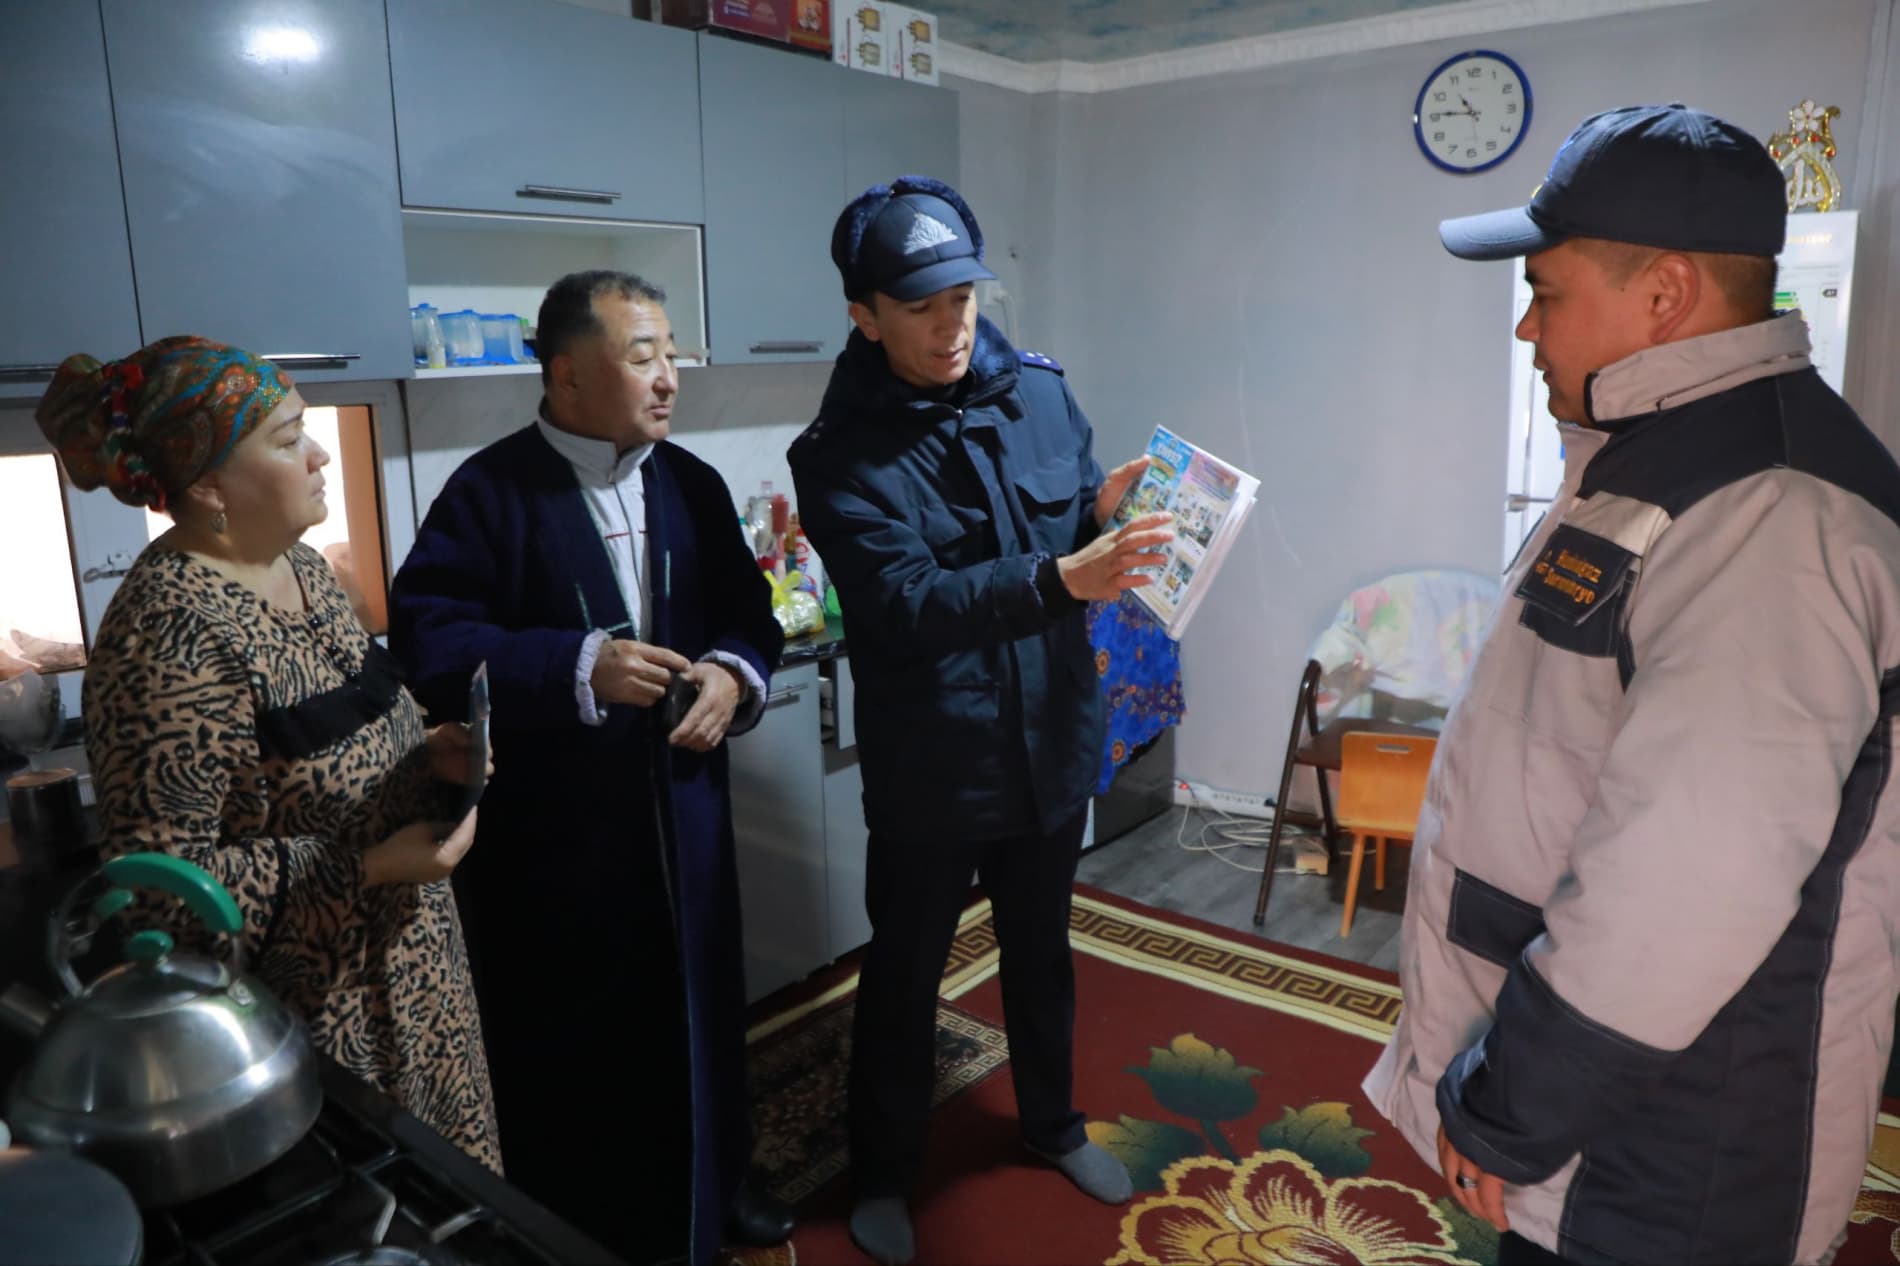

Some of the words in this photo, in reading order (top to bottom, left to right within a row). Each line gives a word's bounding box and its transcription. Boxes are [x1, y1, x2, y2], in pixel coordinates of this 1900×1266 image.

[1450, 75, 1459, 85] 11
[1502, 83, 1513, 94] 2
[1433, 92, 1447, 102] 10
[1507, 103, 1517, 114] 3
[1430, 113, 1441, 122] 9
[1434, 131, 1445, 141] 8
[1448, 144, 1458, 155] 7
[1485, 140, 1497, 151] 5
[1466, 147, 1477, 158] 6
